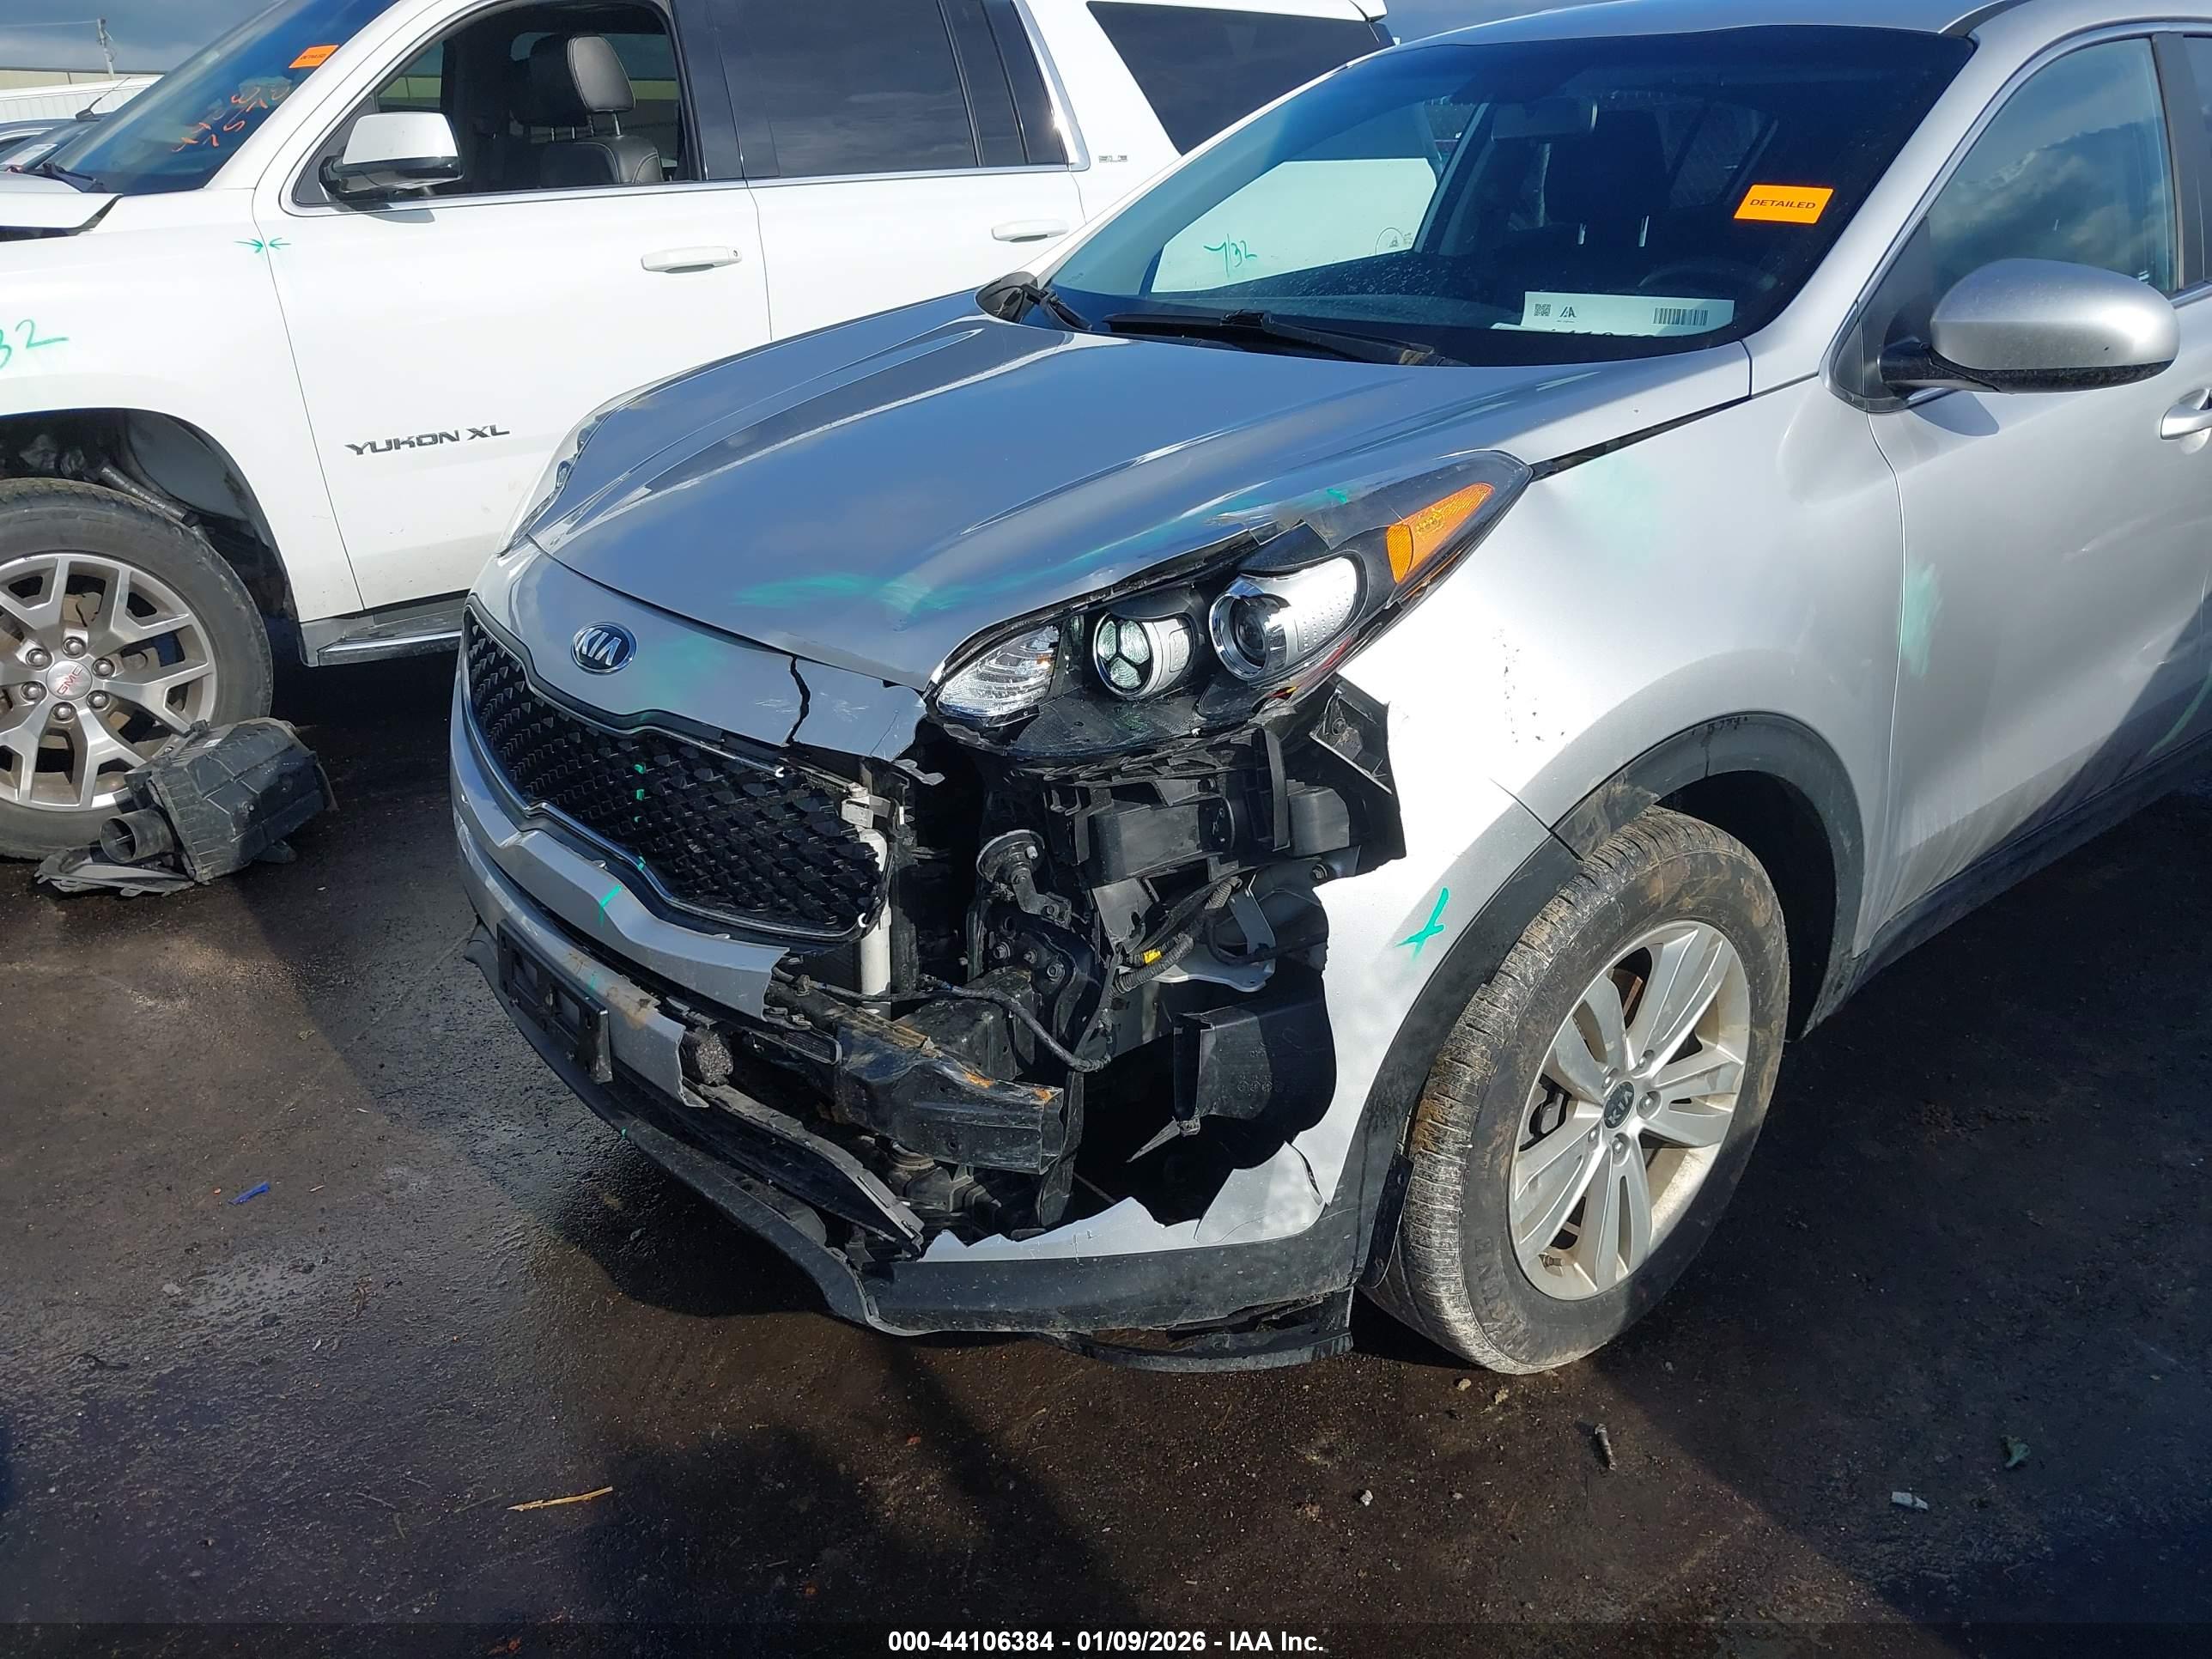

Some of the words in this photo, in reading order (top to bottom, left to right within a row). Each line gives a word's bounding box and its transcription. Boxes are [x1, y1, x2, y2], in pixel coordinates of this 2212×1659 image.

[1750, 198, 1816, 210] DETAILED
[344, 430, 461, 456] YUKON
[466, 424, 511, 441] XL
[575, 628, 623, 666] KIA
[57, 665, 83, 696] GMC
[1608, 1091, 1633, 1125] KIA
